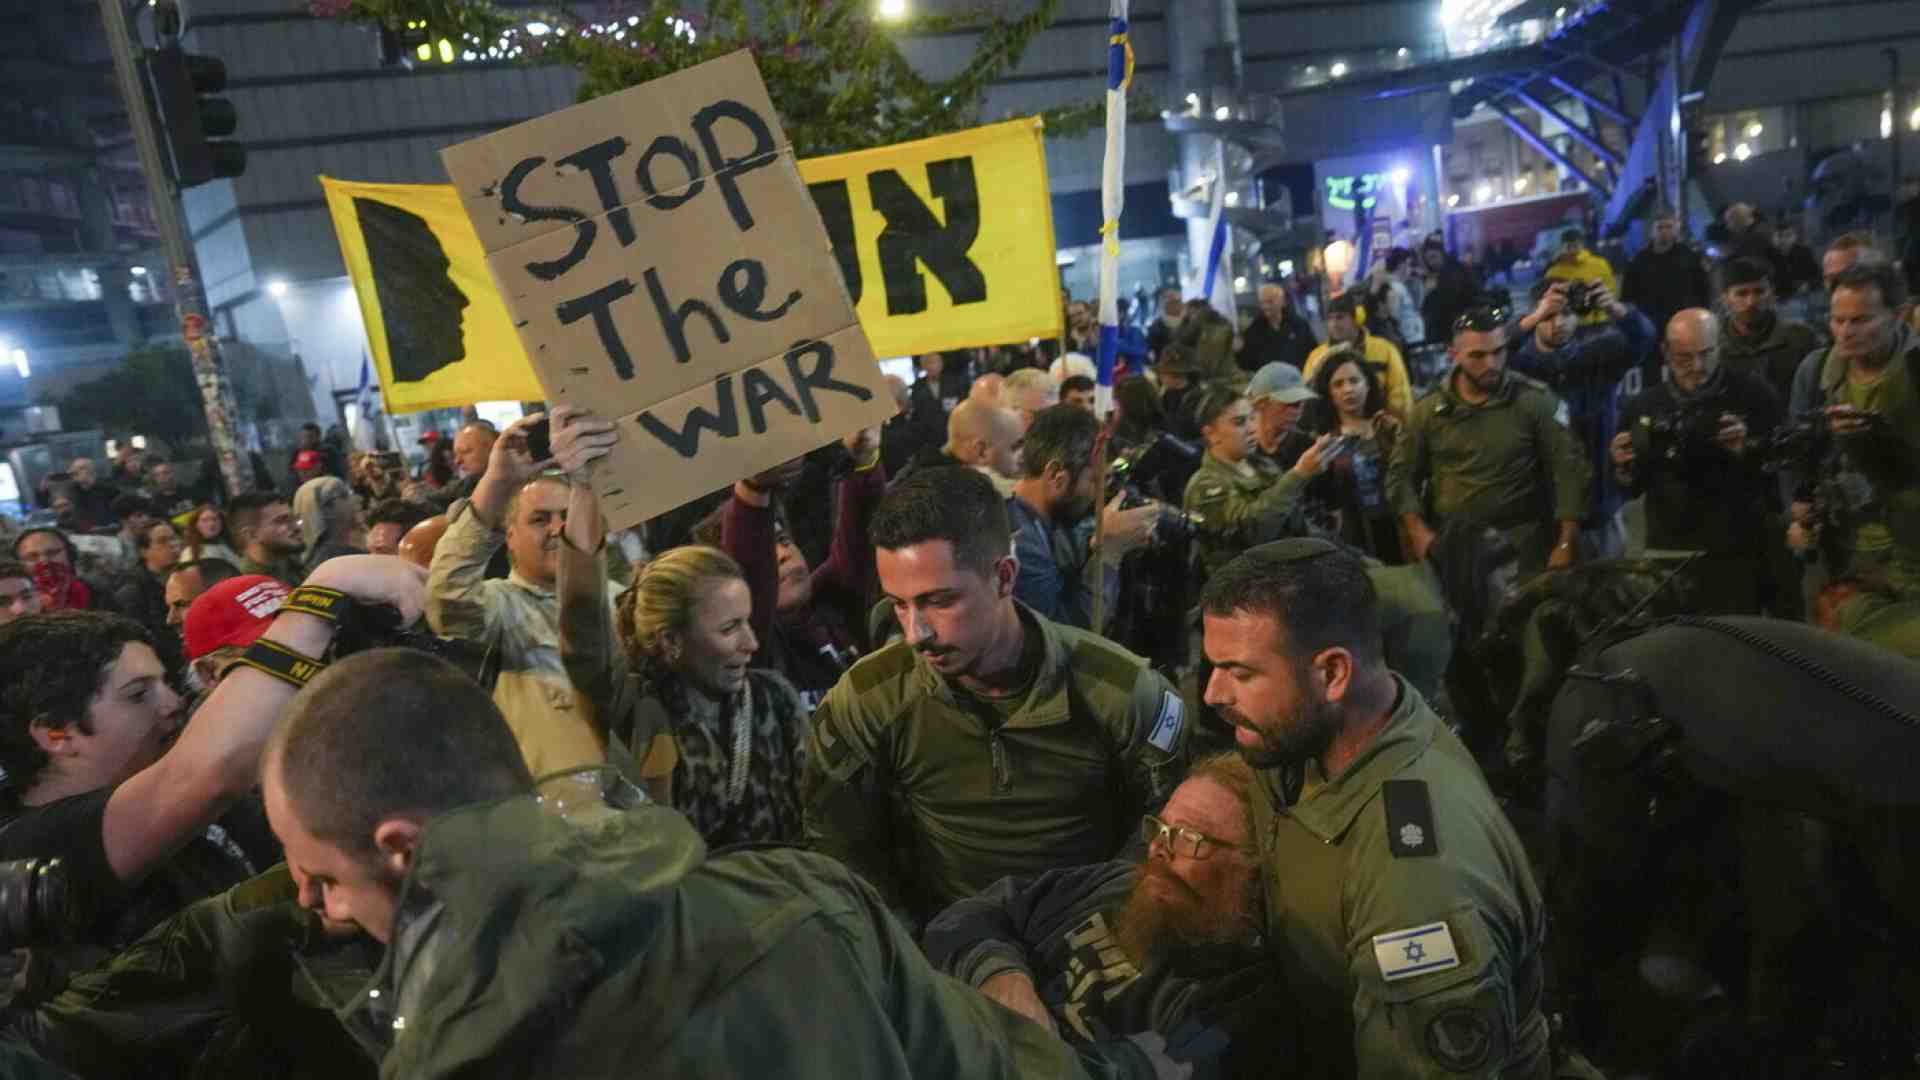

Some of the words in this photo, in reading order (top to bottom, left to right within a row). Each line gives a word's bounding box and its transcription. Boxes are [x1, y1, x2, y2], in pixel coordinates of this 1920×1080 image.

[501, 100, 777, 280] STOP
[556, 259, 803, 380] The
[637, 339, 873, 458] WAR
